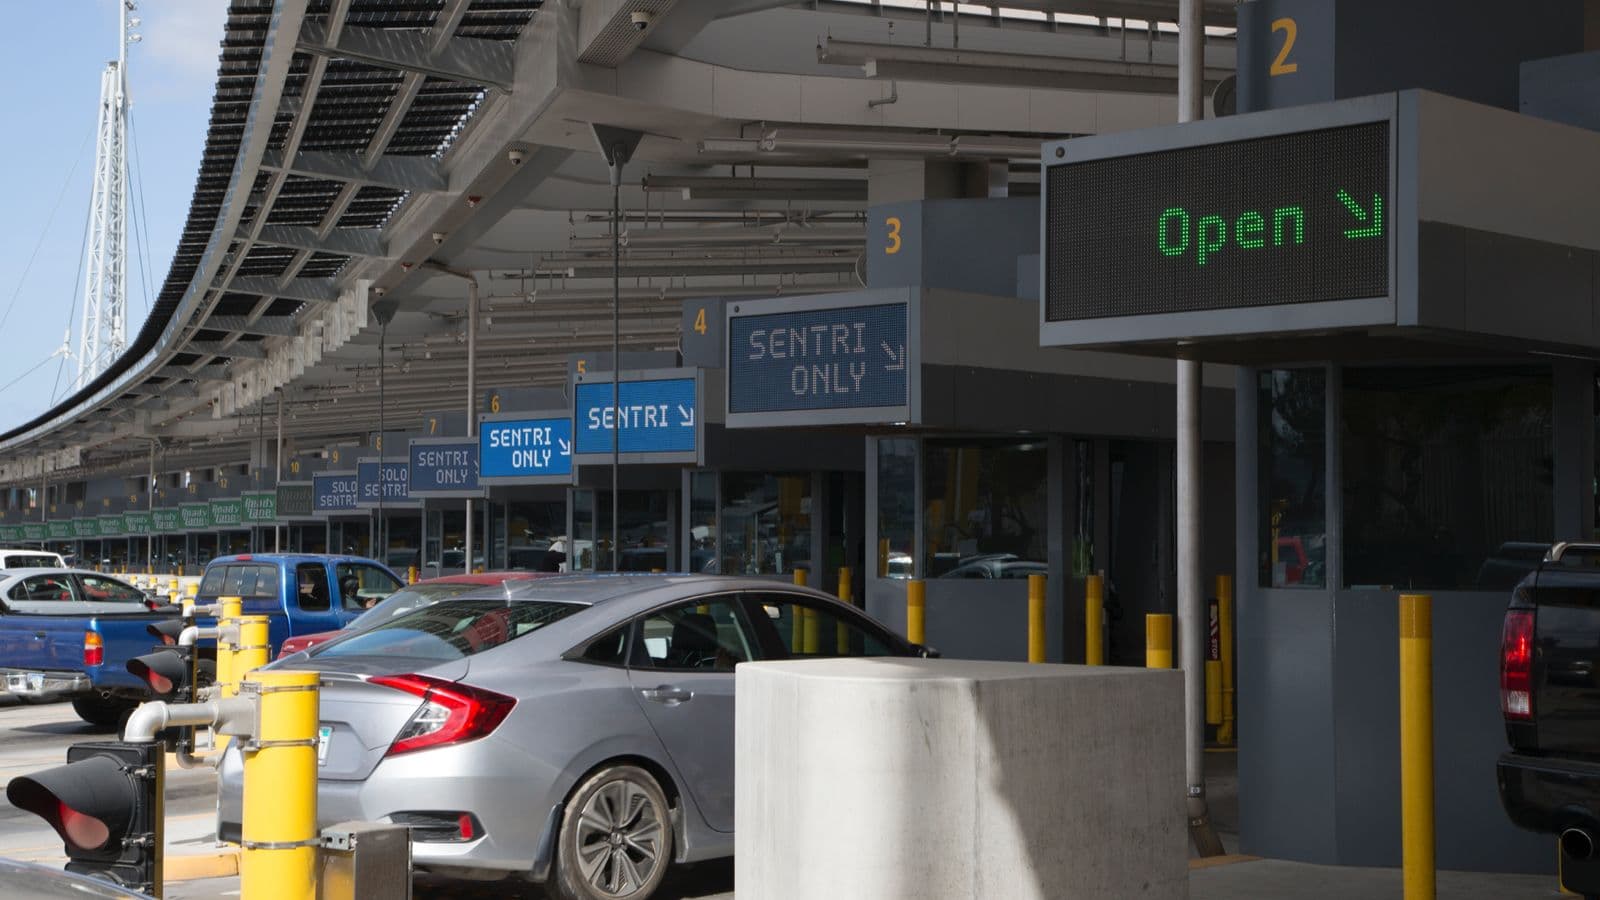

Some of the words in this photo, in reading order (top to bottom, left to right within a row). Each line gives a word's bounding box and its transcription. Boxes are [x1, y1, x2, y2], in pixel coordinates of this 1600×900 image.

[1269, 17, 1298, 76] 2
[884, 217, 902, 254] 3
[1158, 205, 1304, 266] Open
[694, 308, 708, 336] 4
[749, 322, 866, 360] SENTRI
[577, 360, 586, 374] 5
[791, 361, 866, 396] ONLY
[491, 395, 500, 414] 6
[588, 404, 669, 430] SENTRI
[429, 418, 438, 435] 7
[490, 427, 552, 448] SENTRI
[332, 451, 339, 464] 9
[418, 450, 469, 467] SENTRI
[512, 449, 552, 468] ONLY
[290, 461, 299, 473] 10
[378, 468, 407, 482] SOLO
[436, 469, 469, 484] ONLY
[332, 481, 357, 493] SOLO
[365, 483, 407, 497] SENTRI
[320, 494, 357, 507] SENTRI
